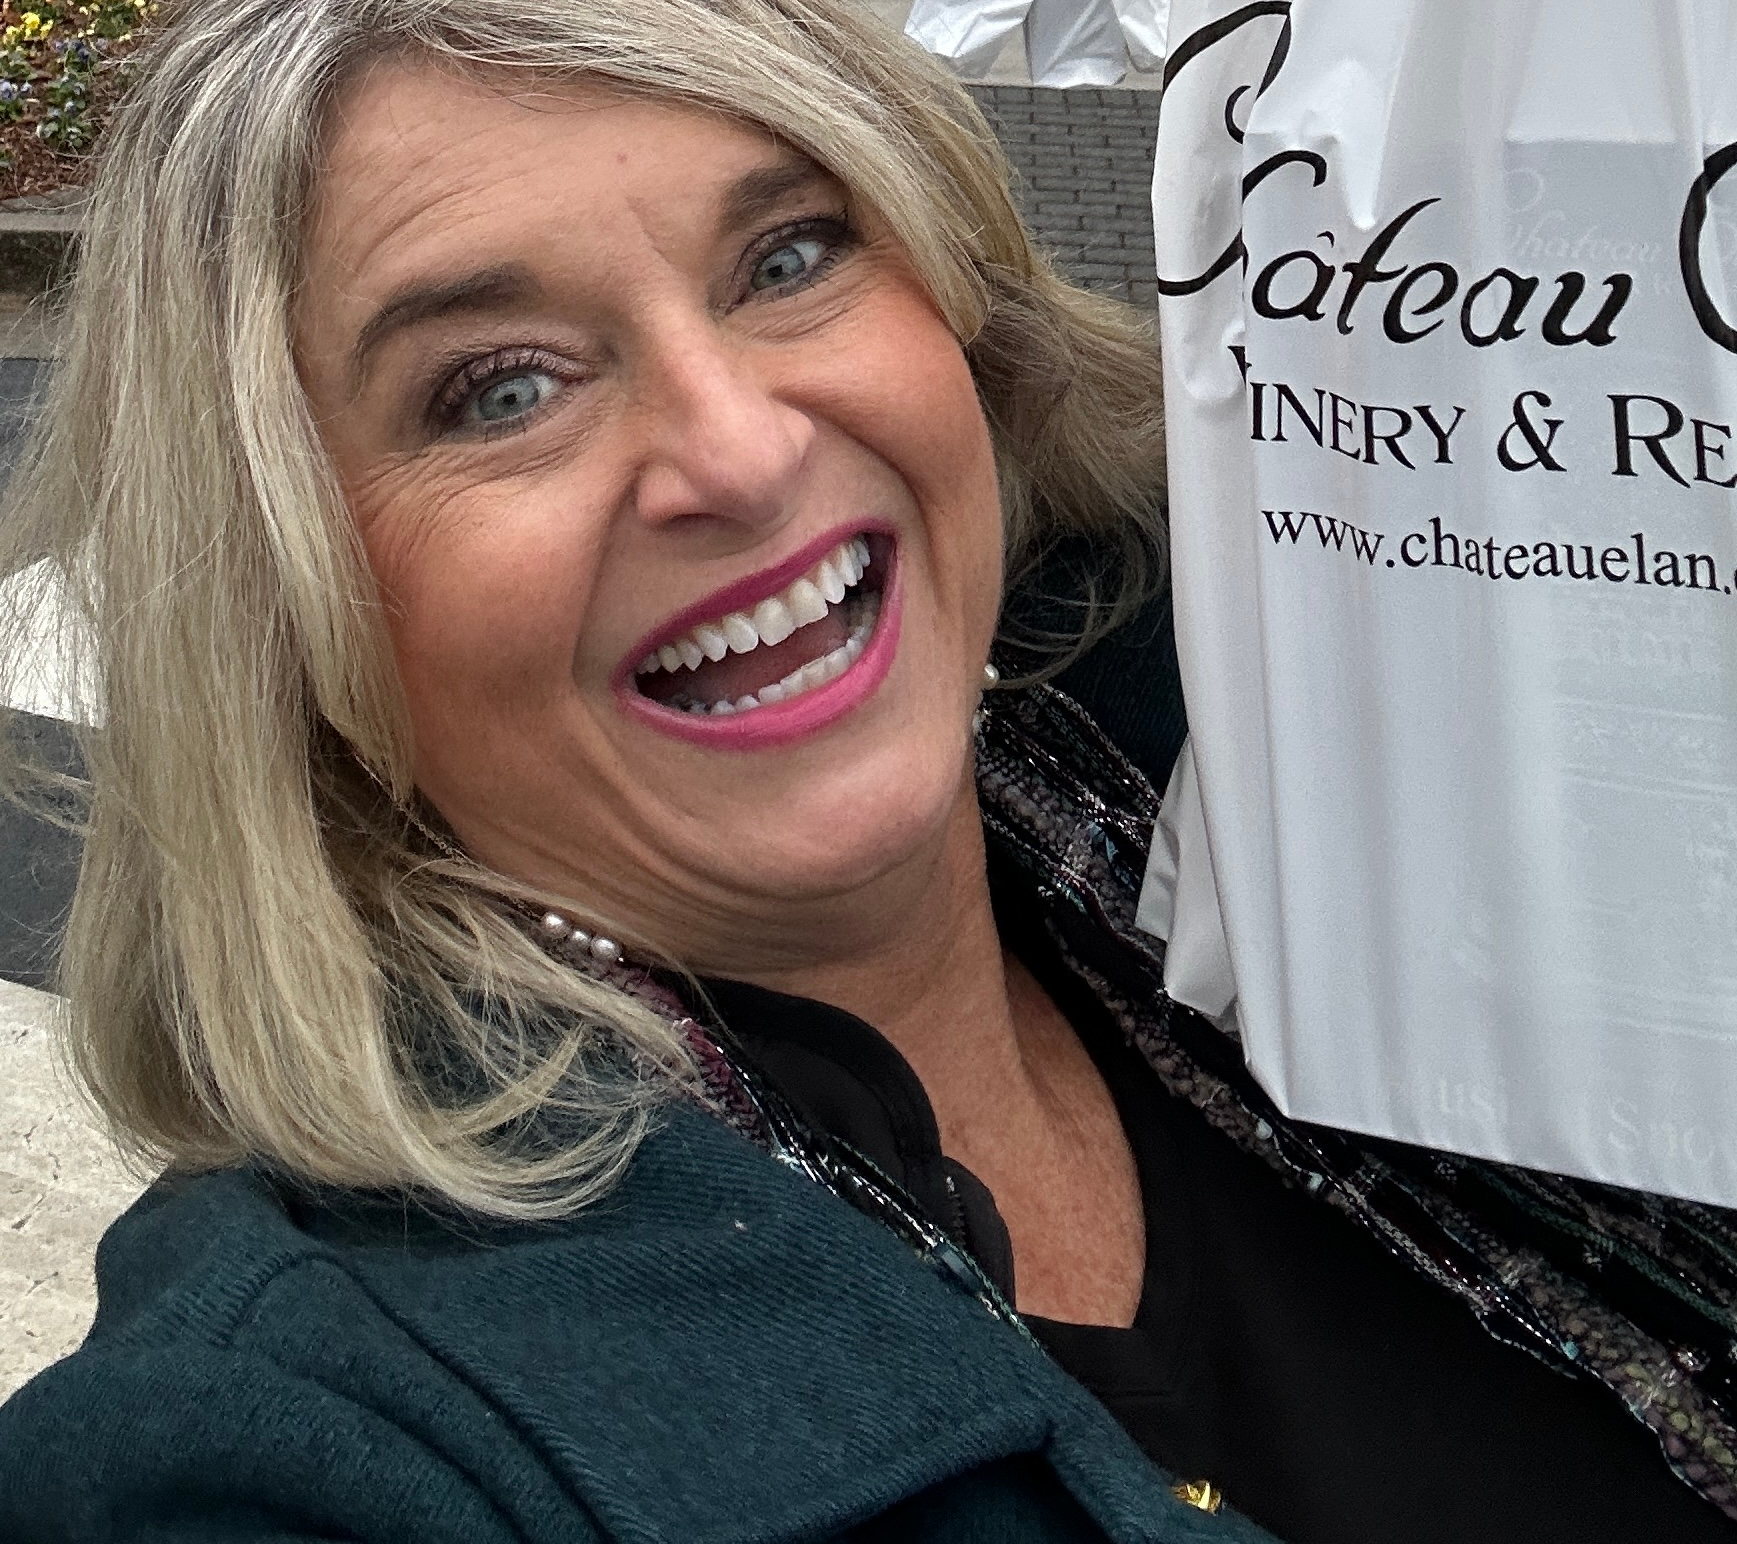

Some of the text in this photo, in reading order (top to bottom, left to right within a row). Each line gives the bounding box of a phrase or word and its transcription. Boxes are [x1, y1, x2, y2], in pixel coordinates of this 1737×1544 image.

[1227, 344, 1466, 471] INERY
[1496, 389, 1568, 474] &
[1261, 509, 1737, 596] www.chateauelan.
